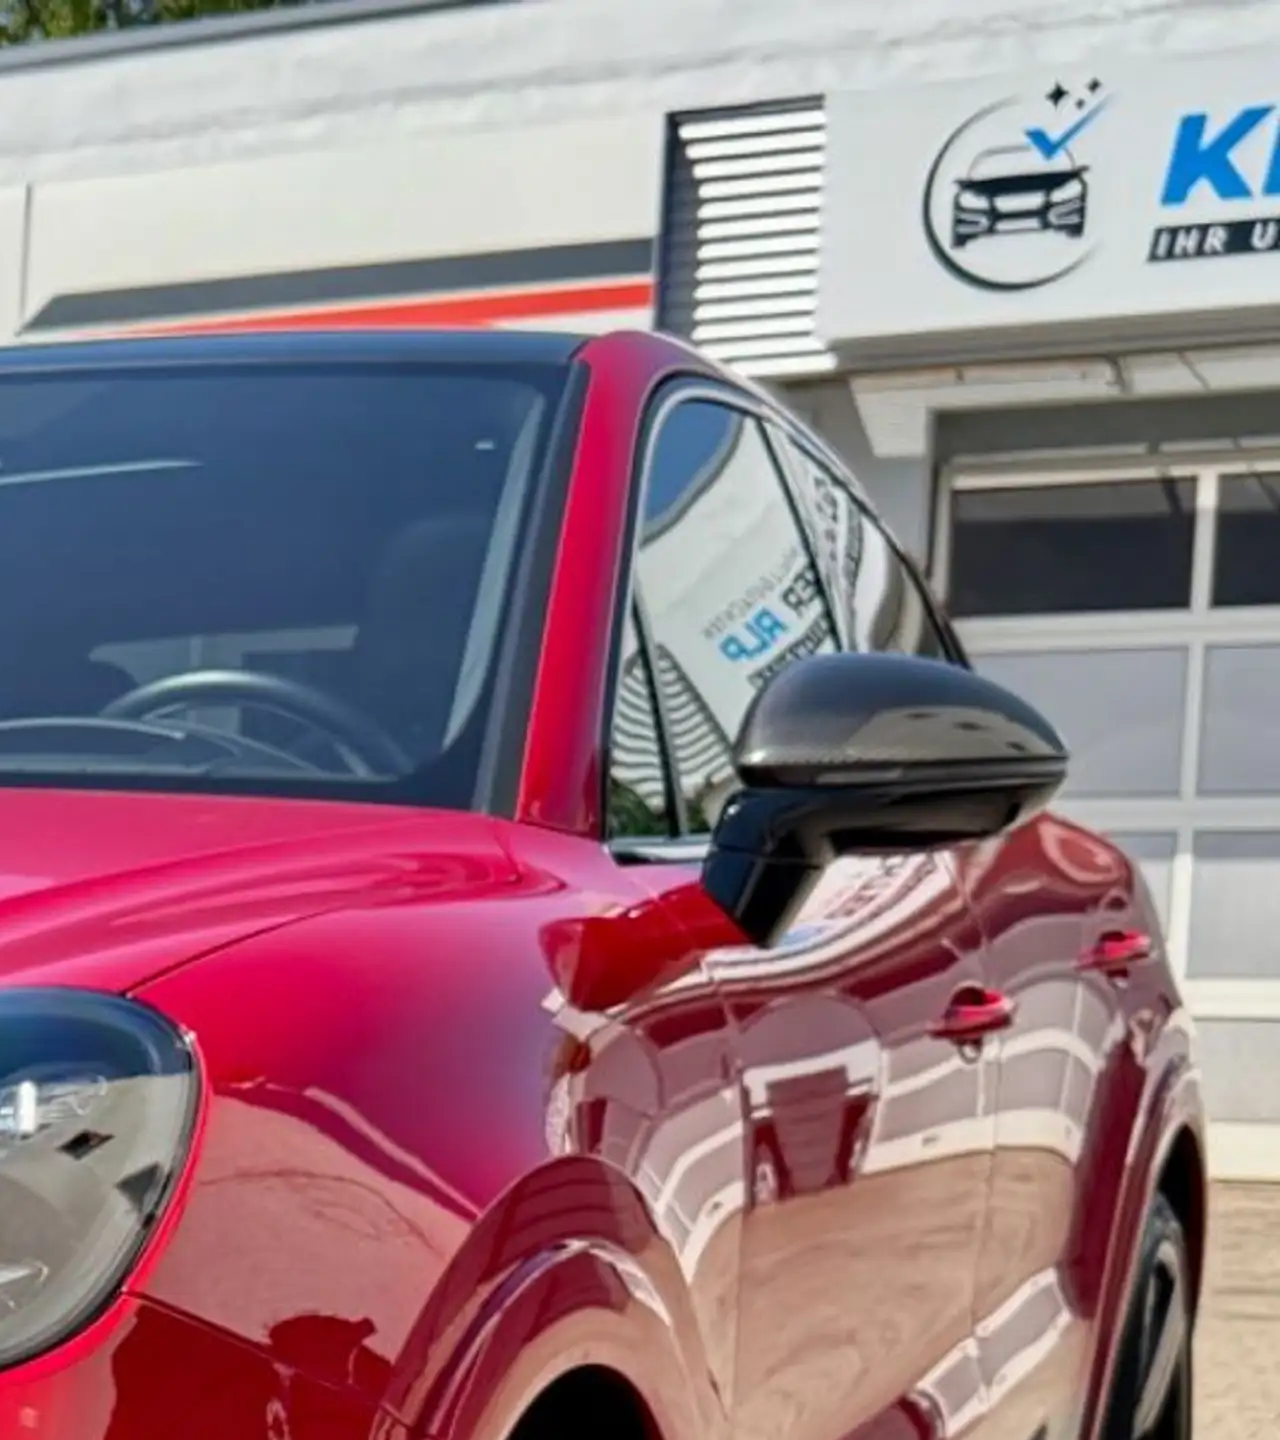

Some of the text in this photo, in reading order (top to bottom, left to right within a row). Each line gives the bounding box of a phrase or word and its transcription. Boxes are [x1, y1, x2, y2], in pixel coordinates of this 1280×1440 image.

[1160, 104, 1280, 206] K
[1156, 221, 1280, 259] IHR U
